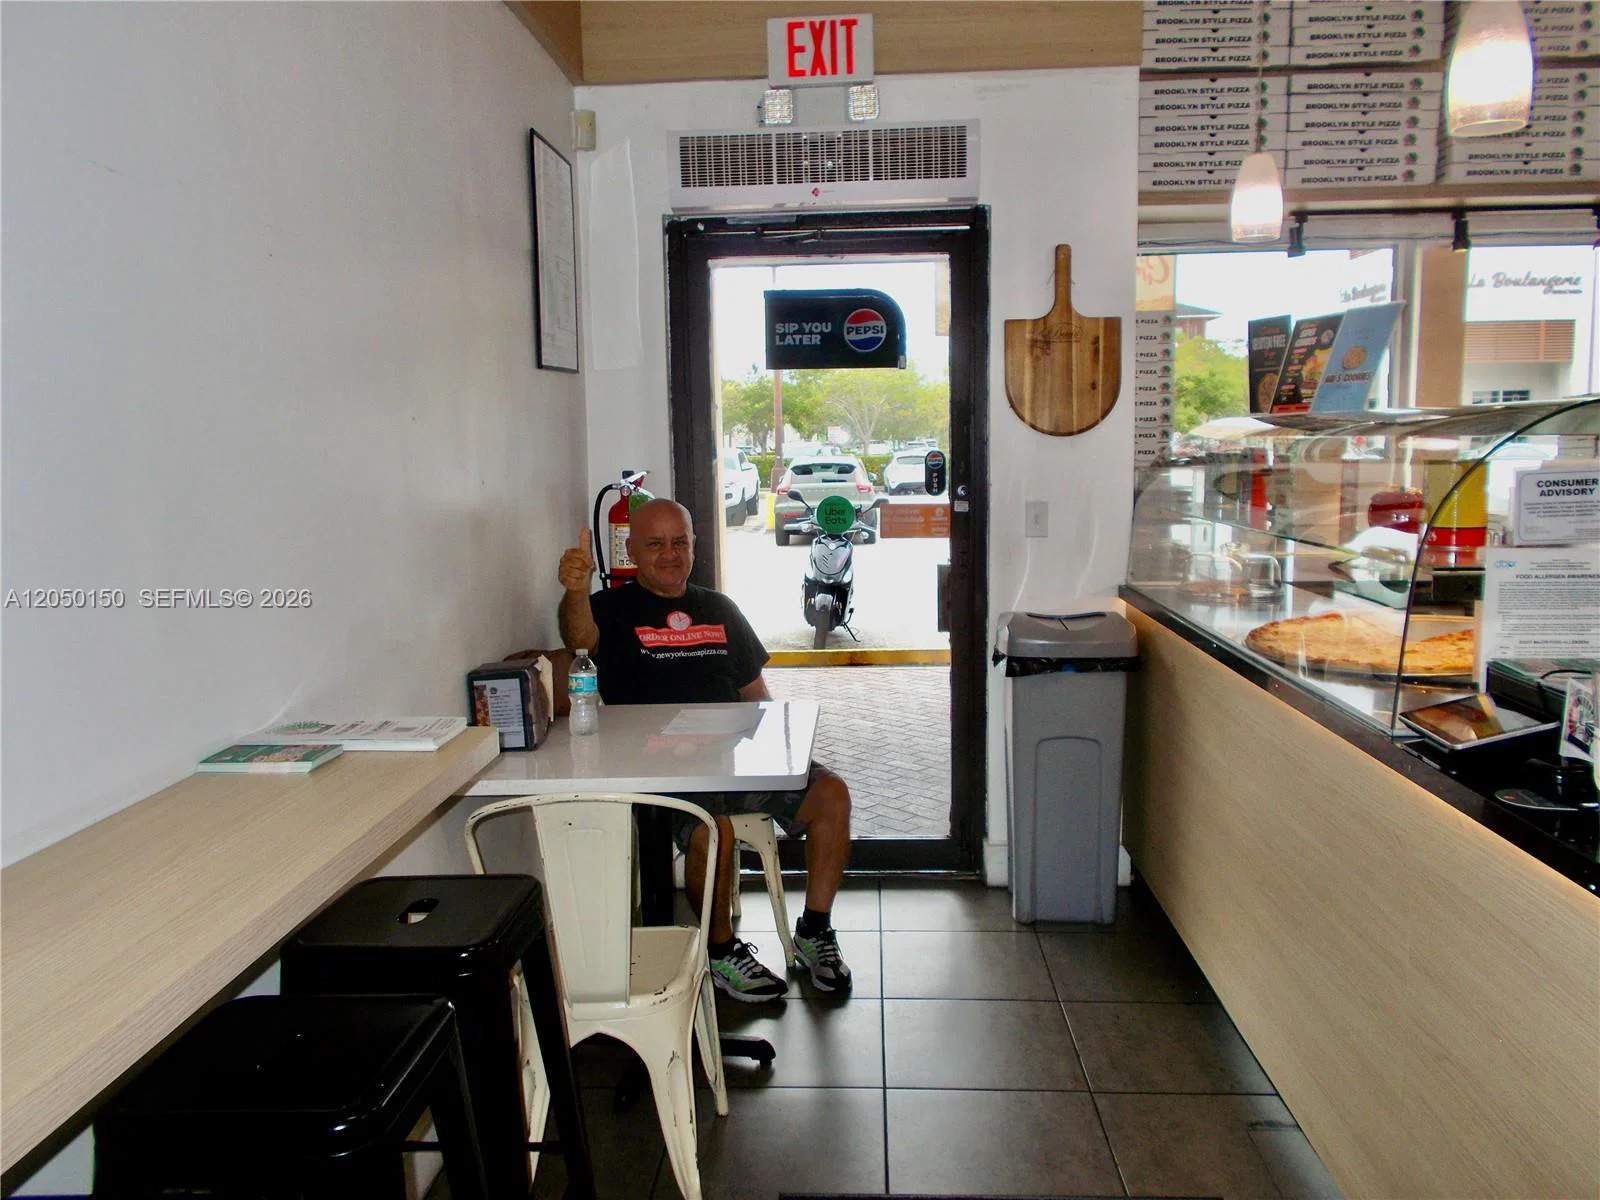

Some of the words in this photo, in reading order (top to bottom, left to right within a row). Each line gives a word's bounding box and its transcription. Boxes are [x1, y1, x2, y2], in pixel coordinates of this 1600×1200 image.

[786, 18, 858, 78] EXIT
[1492, 270, 1582, 294] Boulangerie
[776, 322, 799, 334] SIP
[802, 322, 832, 333] YOU
[846, 326, 884, 336] PEPSI
[776, 334, 821, 345] LATER
[1536, 478, 1599, 488] CONSUMER
[1540, 488, 1596, 496] ADVISORY
[824, 507, 846, 516] Uber
[824, 516, 846, 524] Eats
[640, 632, 670, 642] ORDER
[670, 631, 702, 641] ONLINE
